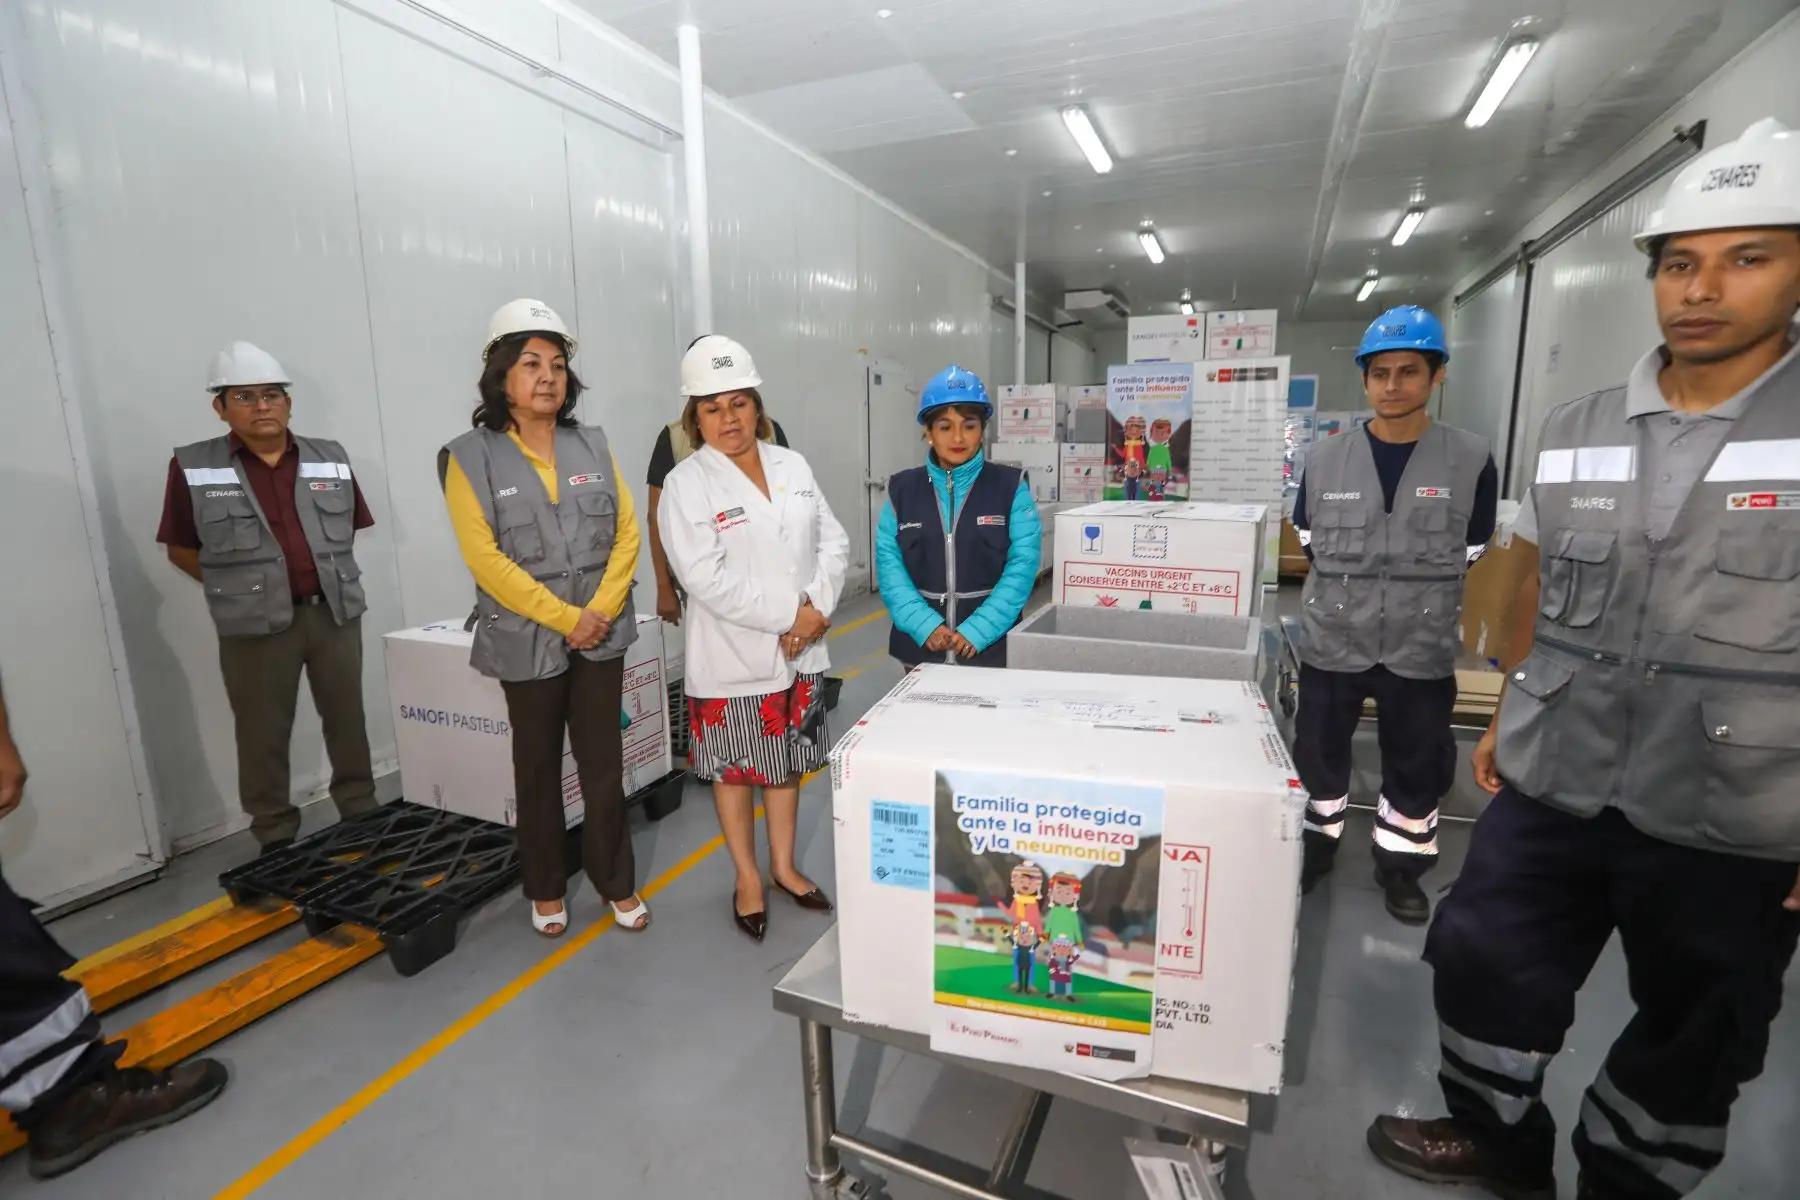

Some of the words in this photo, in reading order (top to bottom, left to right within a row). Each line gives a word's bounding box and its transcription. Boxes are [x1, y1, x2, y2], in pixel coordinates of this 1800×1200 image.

[1112, 376, 1144, 385] Familia
[1145, 375, 1190, 385] protegida
[1136, 385, 1144, 393] la
[1146, 384, 1187, 393] influenza
[1119, 394, 1124, 402] y
[1126, 393, 1135, 401] la
[1322, 492, 1360, 500] CENARES
[1104, 567, 1148, 580] VACCINS
[1150, 571, 1193, 582] URGENT
[1069, 575, 1128, 588] CONSERVER
[1131, 580, 1164, 590] ENTRE
[1192, 583, 1205, 593] ET
[400, 704, 450, 727] SANOFI
[452, 712, 510, 737] PASTEUR
[957, 795, 1029, 814] Familia
[1035, 803, 1142, 827] protegida
[962, 815, 1007, 832] ante
[1013, 818, 1031, 834] la
[1038, 820, 1135, 846] influenza
[974, 835, 986, 850] y
[991, 833, 1009, 849] la
[1156, 1008, 1182, 1021] PVT.
[1185, 1011, 1212, 1026] LTD.
